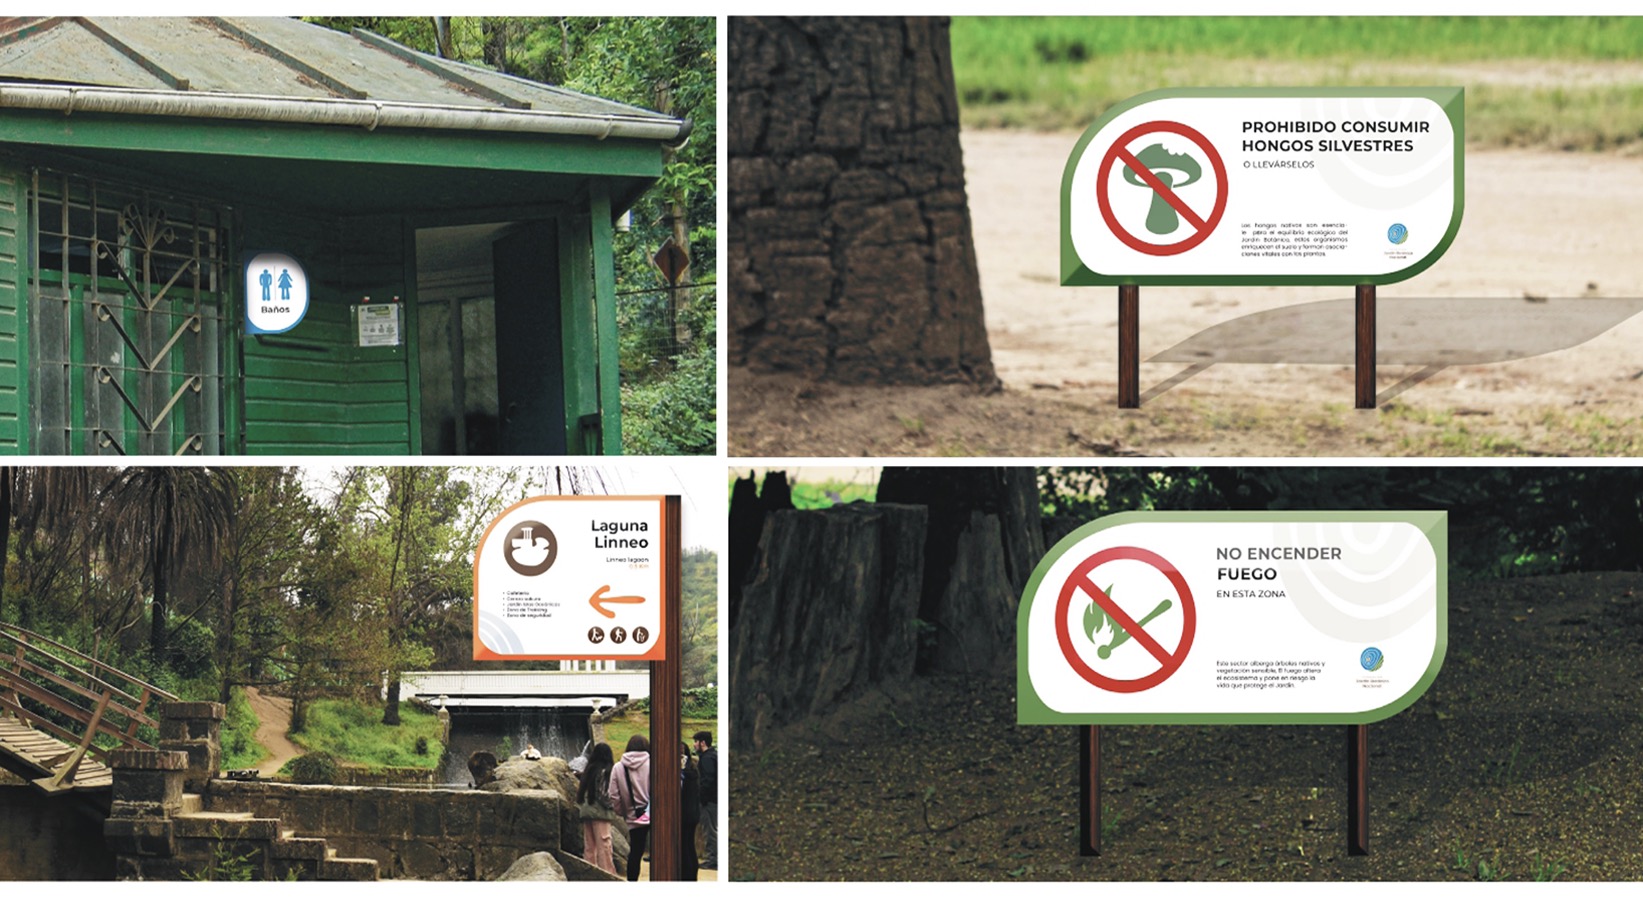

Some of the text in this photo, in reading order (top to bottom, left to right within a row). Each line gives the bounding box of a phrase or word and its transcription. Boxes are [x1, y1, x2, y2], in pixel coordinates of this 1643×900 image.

[1242, 121, 1430, 133] PROHIBIDO CONSUMIR
[1242, 140, 1414, 152] HONGOS SILVESTRES
[1253, 160, 1315, 168] LLEVÁRSELOS
[592, 520, 648, 535] Laguna
[595, 535, 649, 548] Linneo
[1217, 547, 1342, 560] NO ENCENDER
[1218, 568, 1277, 580] FUEGO
[1217, 590, 1286, 598] EN ESTA ZONA
